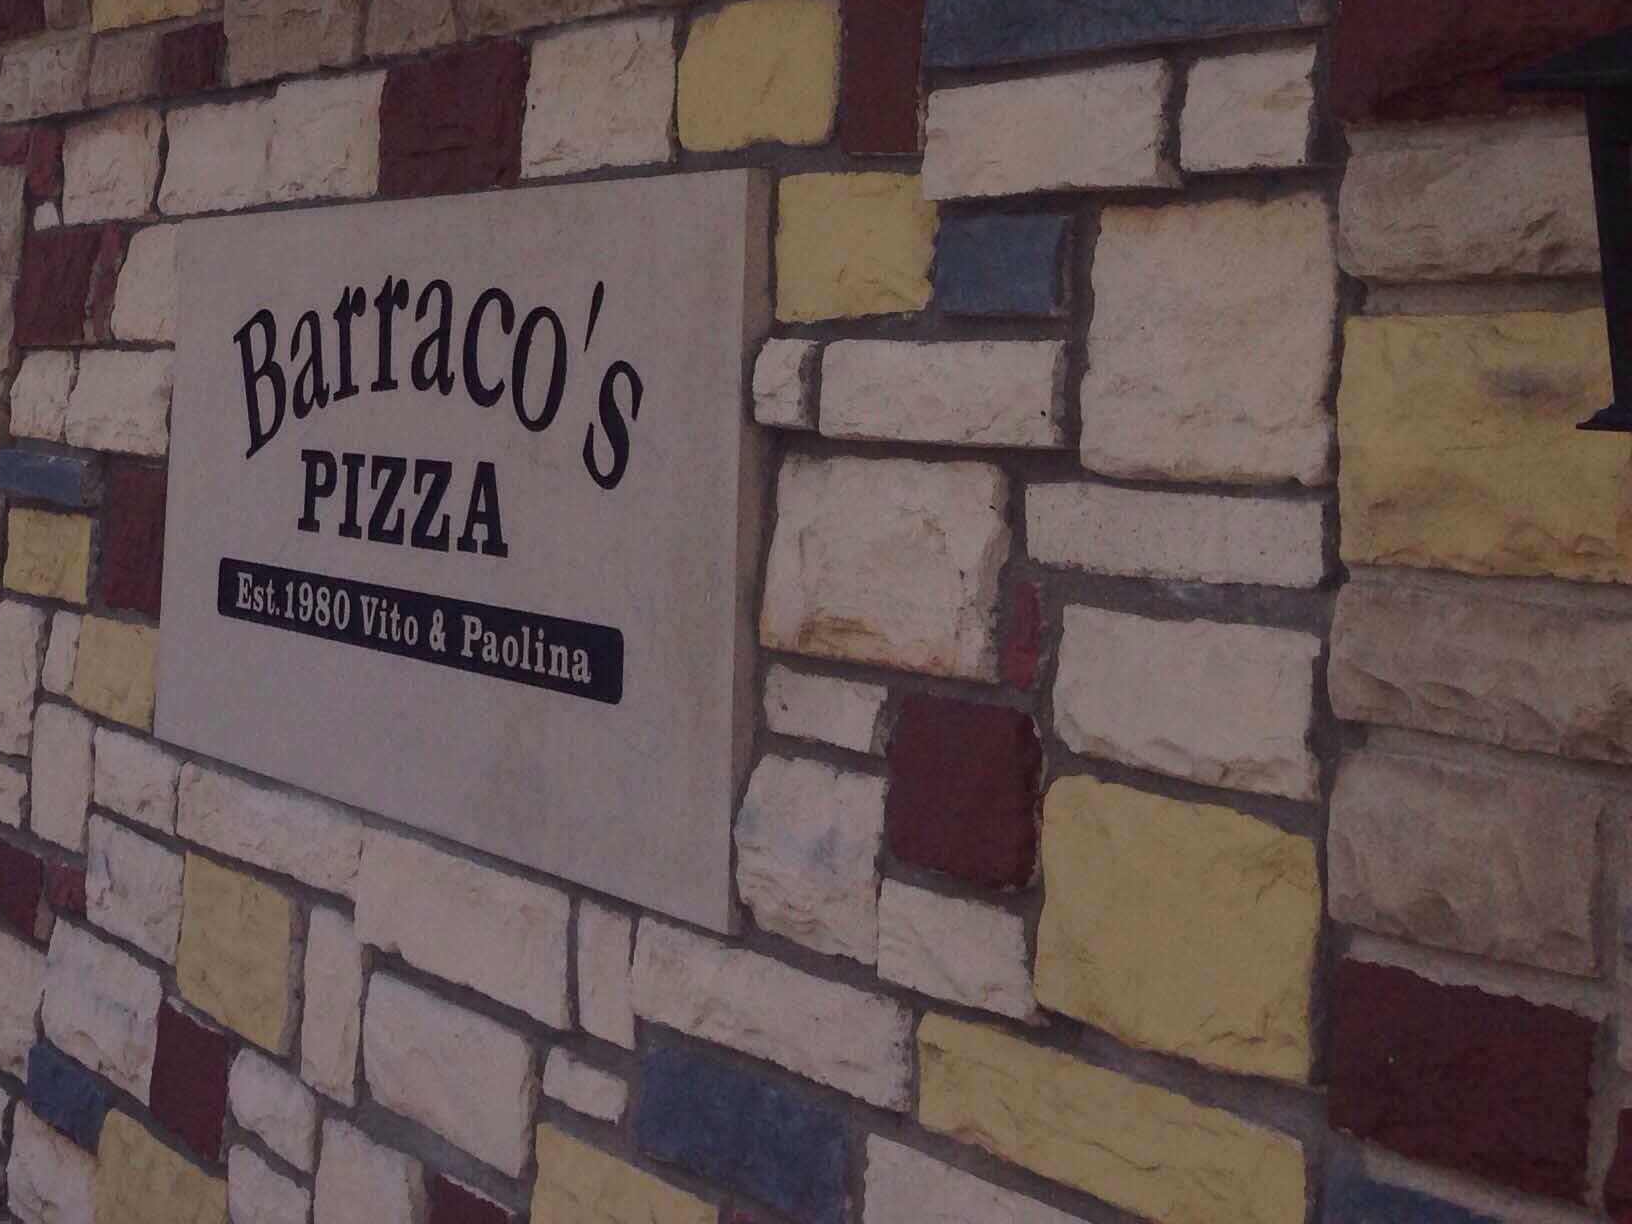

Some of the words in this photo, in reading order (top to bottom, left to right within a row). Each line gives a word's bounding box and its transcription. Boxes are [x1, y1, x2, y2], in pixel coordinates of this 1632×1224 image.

[232, 274, 644, 491] Barraco's
[296, 448, 509, 558] PIZZA
[360, 594, 418, 646] Vito
[428, 608, 447, 653] &
[461, 613, 592, 684] Paolina
